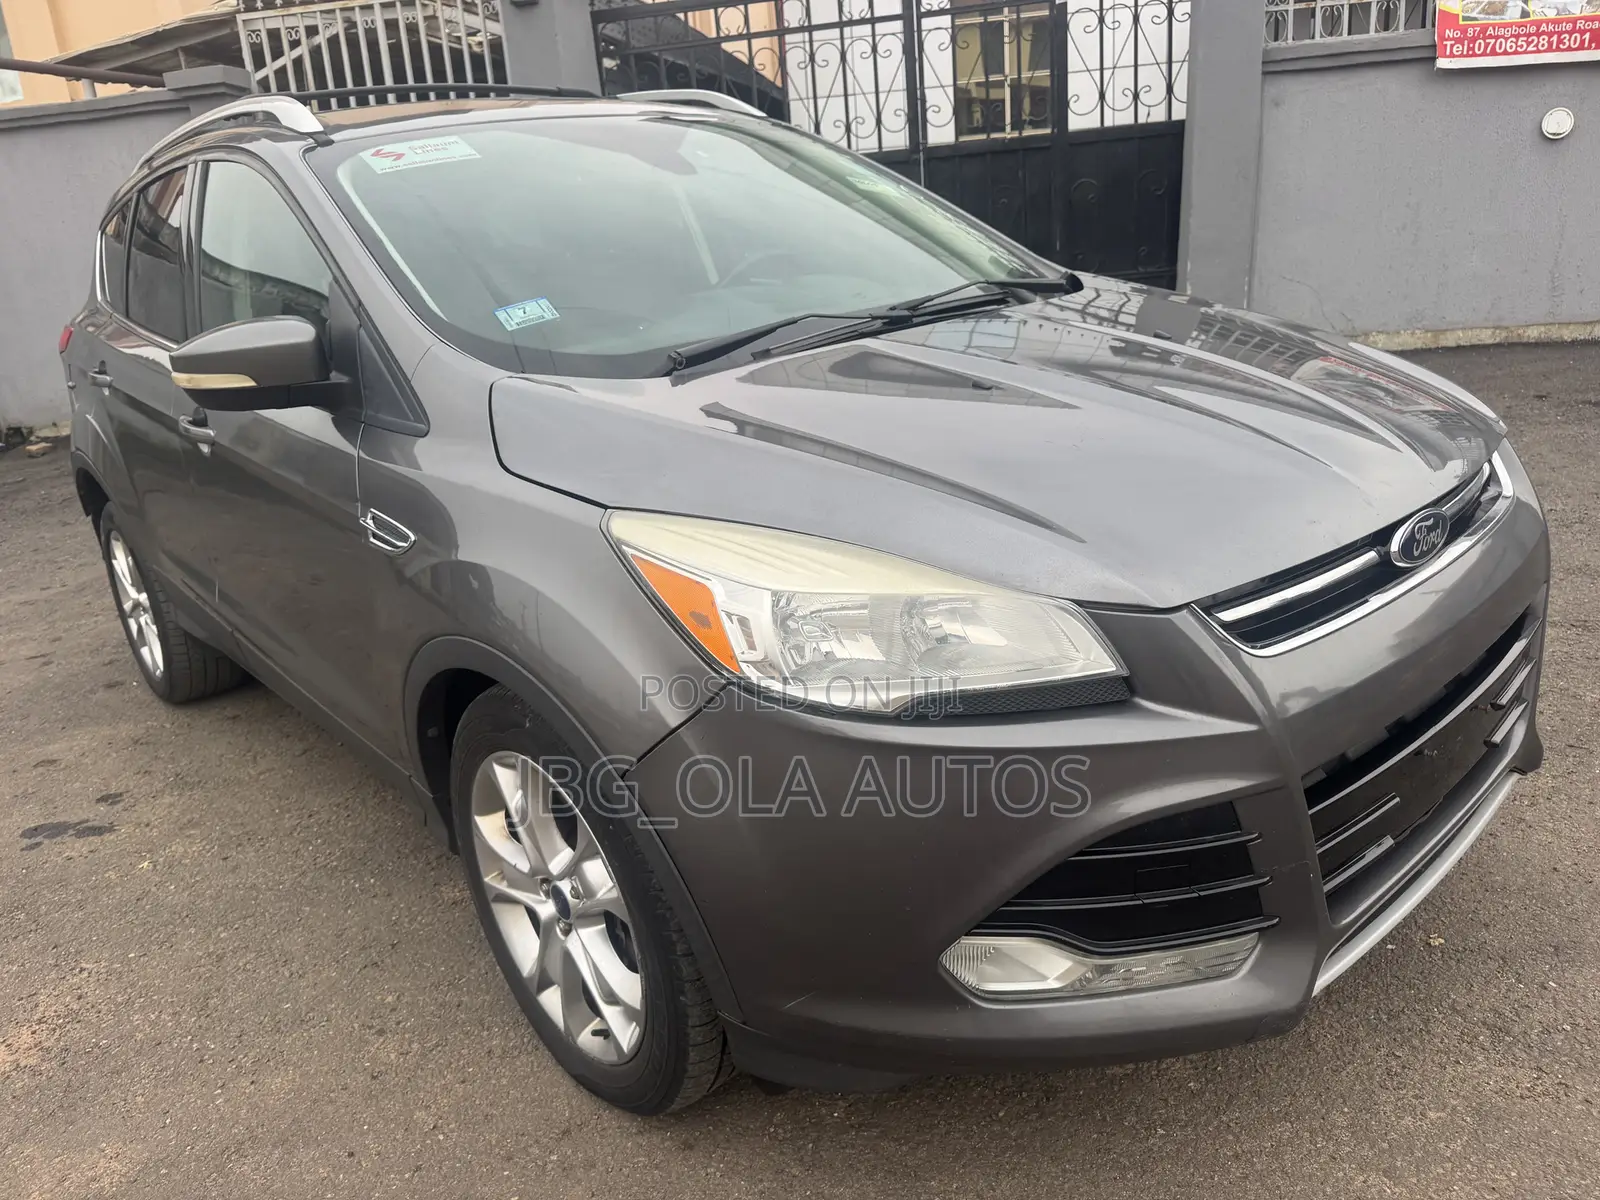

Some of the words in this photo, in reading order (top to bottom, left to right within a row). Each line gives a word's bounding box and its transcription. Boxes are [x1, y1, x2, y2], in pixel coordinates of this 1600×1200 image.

[1445, 28, 1463, 38] No.
[1467, 27, 1483, 38] 87,
[1486, 22, 1537, 37] Alagbole
[1539, 20, 1573, 32] Akute
[1576, 19, 1600, 30] Roa
[1413, 517, 1443, 557] Ford
